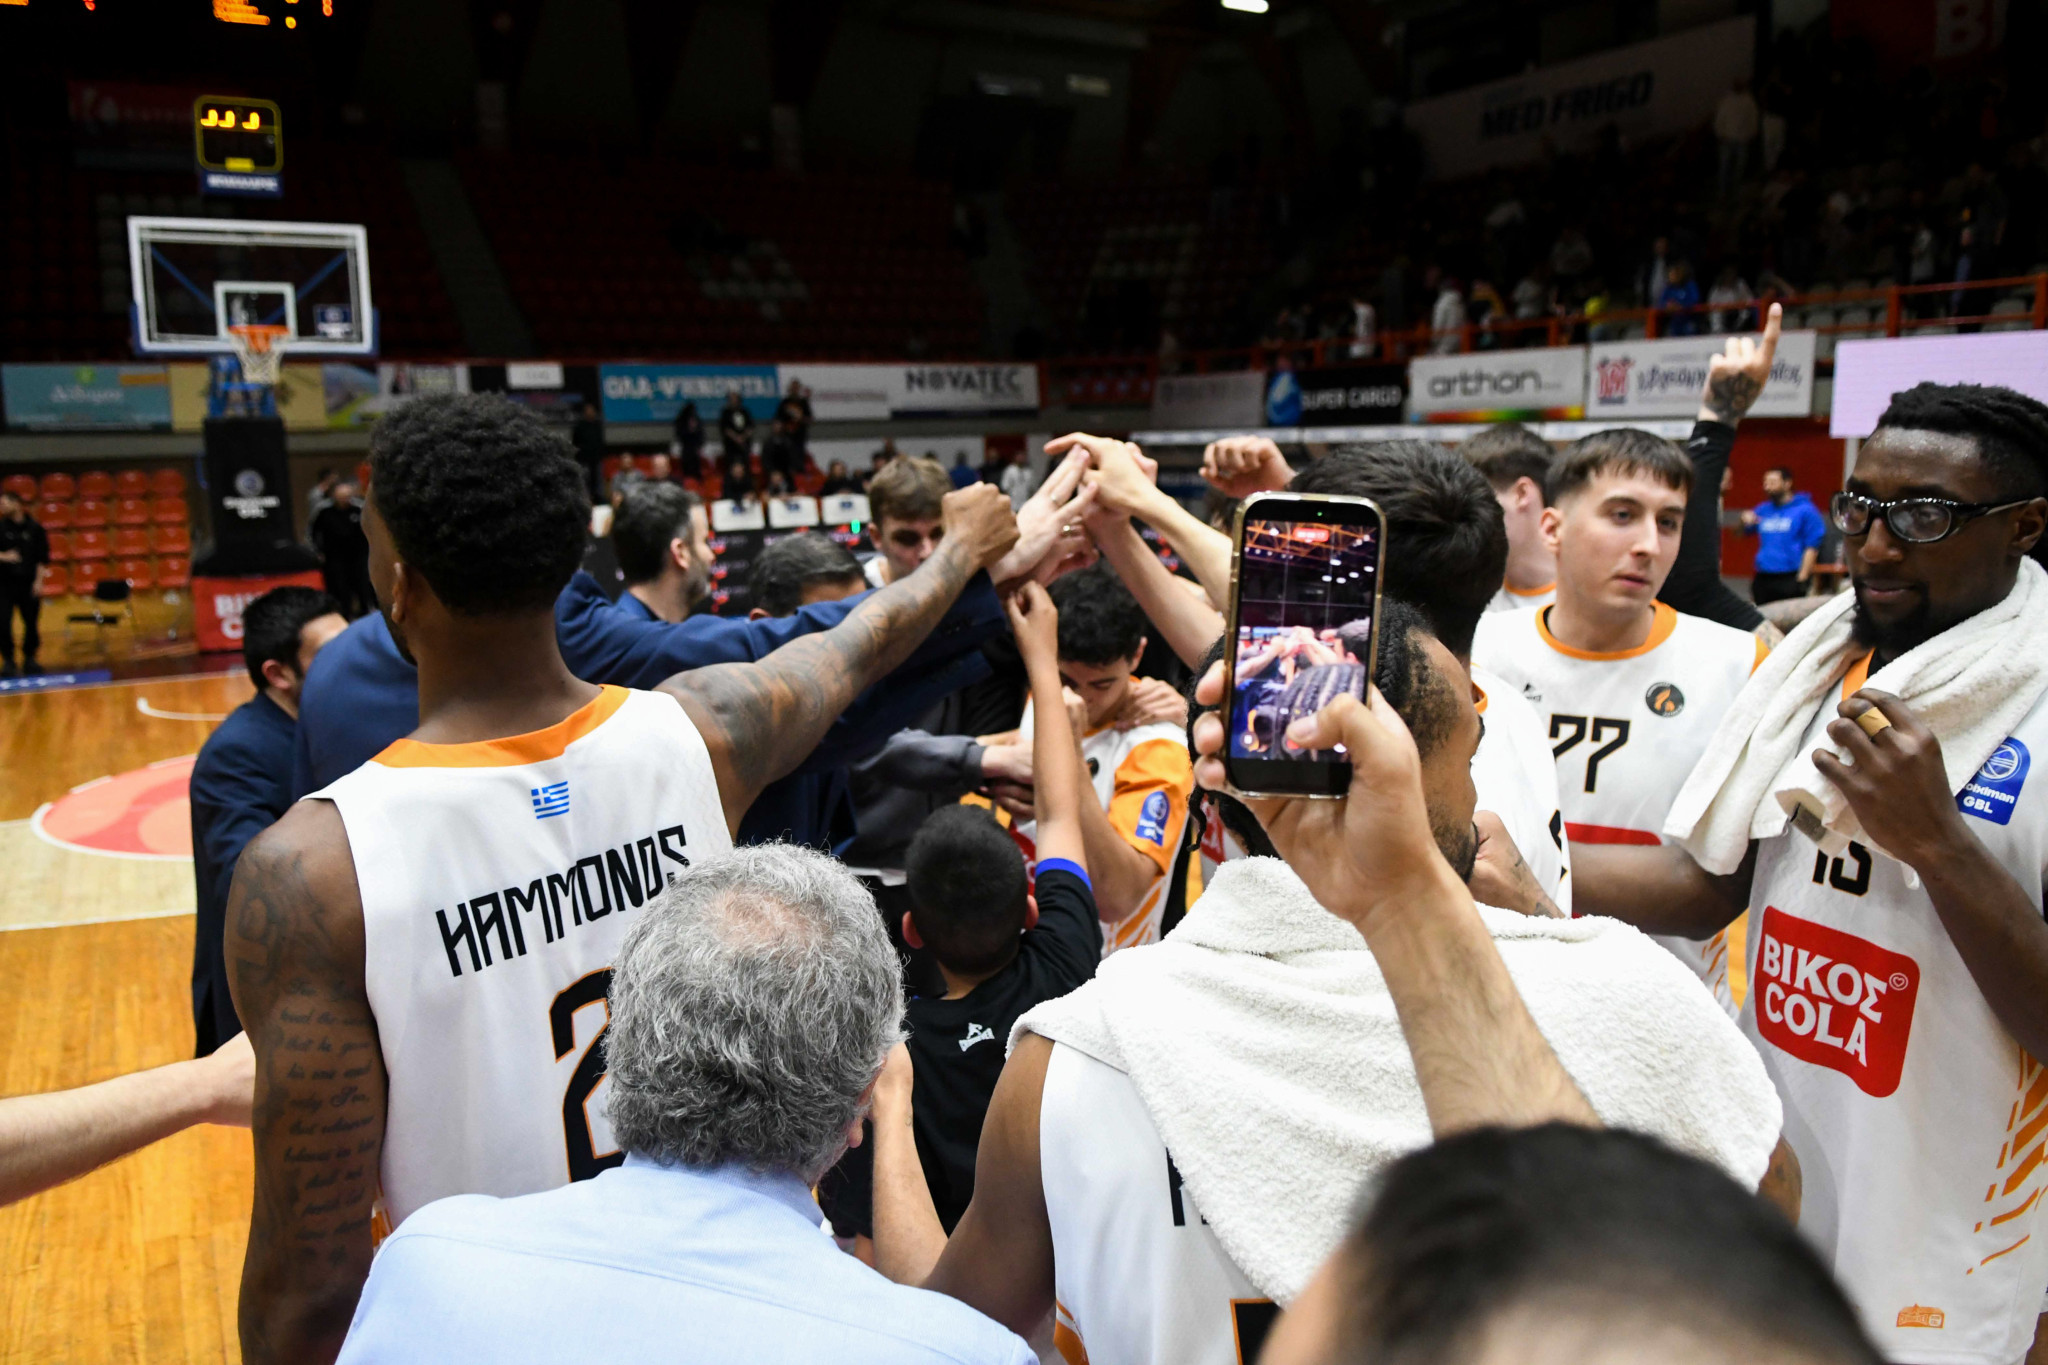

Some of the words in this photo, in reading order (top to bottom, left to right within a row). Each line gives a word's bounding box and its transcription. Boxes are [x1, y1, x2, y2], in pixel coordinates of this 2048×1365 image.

[1481, 98, 1545, 139] MED
[1551, 71, 1653, 123] FRIGO
[905, 368, 1022, 396] NOVATEC
[1549, 713, 1631, 794] 77
[1963, 796, 1993, 814] GBL
[435, 824, 691, 978] HAMMONDS
[1764, 982, 1868, 1068] COLA
